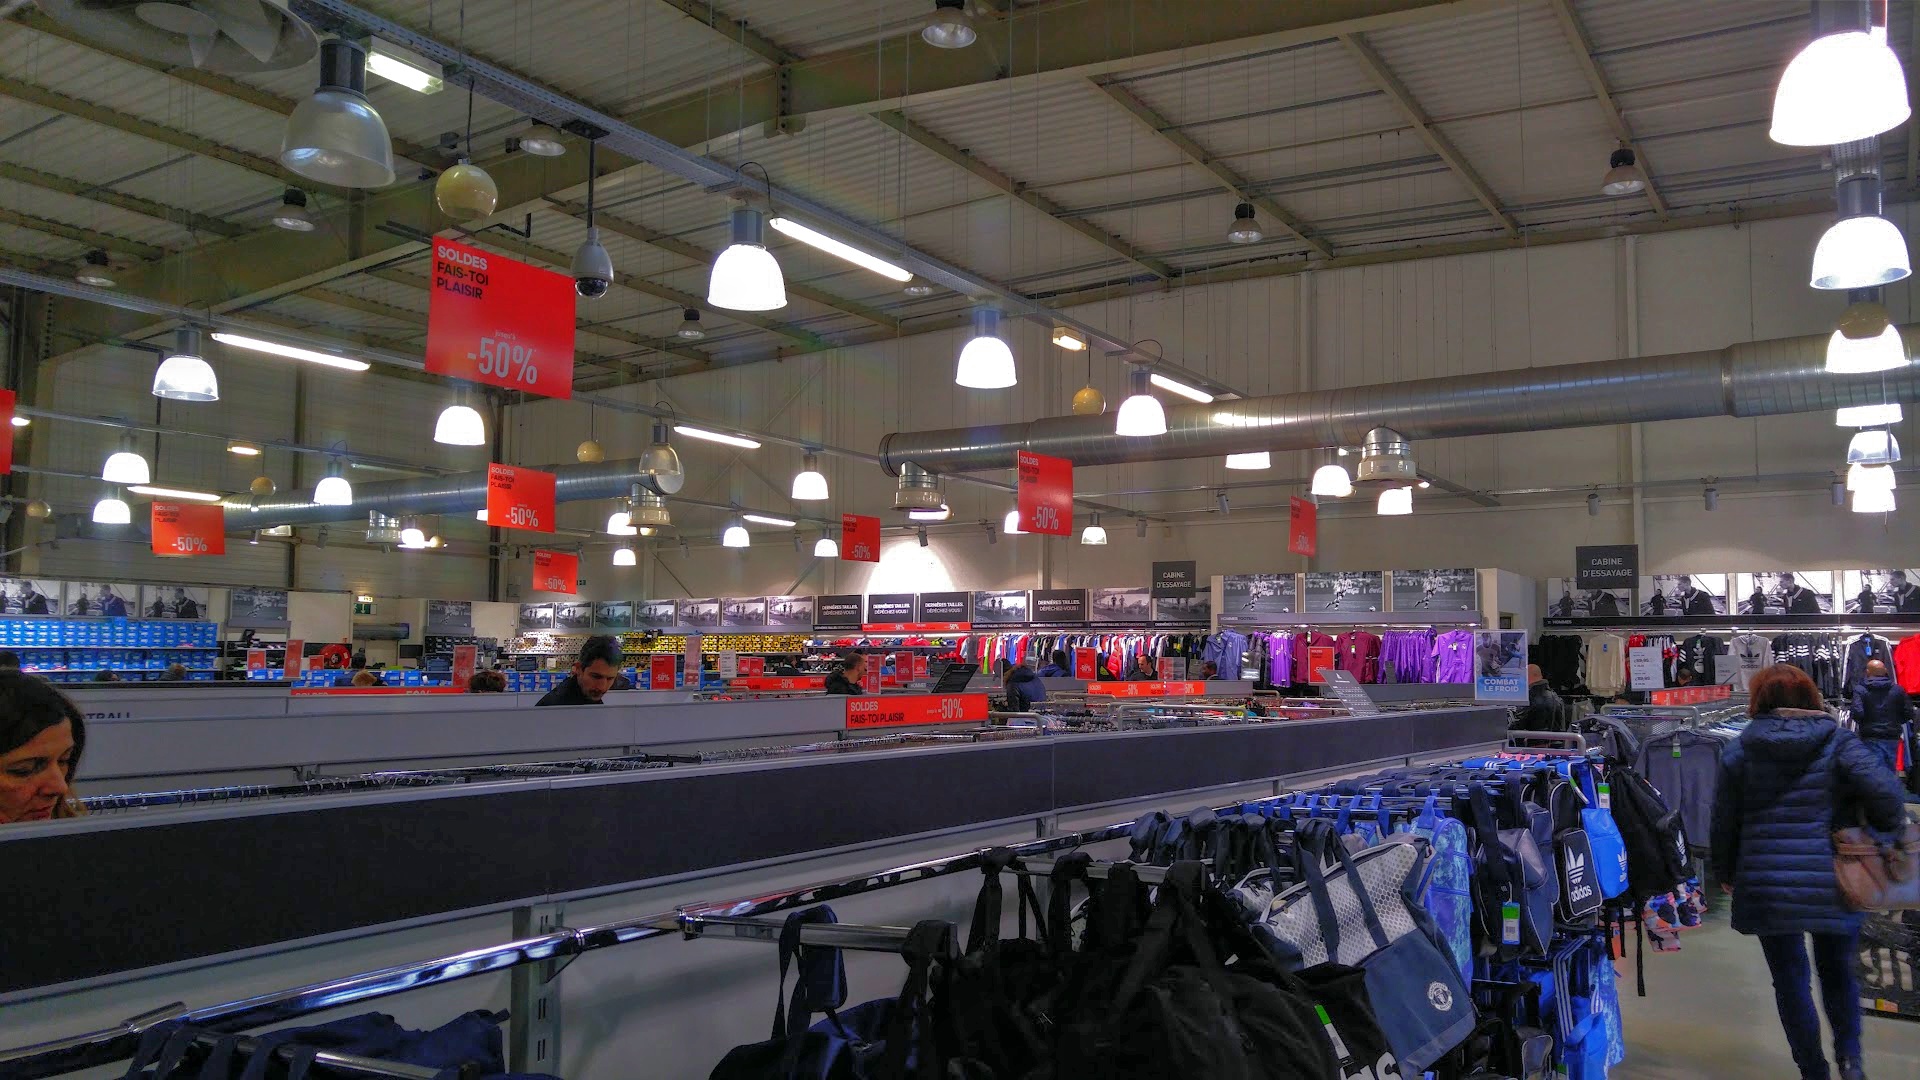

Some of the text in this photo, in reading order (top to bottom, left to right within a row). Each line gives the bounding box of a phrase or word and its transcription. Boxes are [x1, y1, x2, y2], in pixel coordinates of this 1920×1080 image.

[438, 246, 488, 270] SOLDES
[437, 262, 488, 286] FAIS-TOI
[436, 277, 482, 300] PLAISIR
[467, 337, 538, 384] -50%
[1020, 456, 1038, 466] SOLDES
[491, 466, 514, 476] SOLDES
[505, 506, 538, 527] -50%
[1032, 506, 1059, 530] -50%
[172, 536, 208, 551] -50%
[851, 544, 870, 559] -50%
[1592, 558, 1623, 566] CABINE
[1582, 569, 1632, 577] D'ESSAYAGE
[544, 578, 566, 591] -50%
[851, 701, 878, 712] SOLDES
[938, 698, 963, 719] -50%
[850, 713, 904, 724] FAIS-TOI PLAISIR
[1571, 885, 1592, 902] adidas
